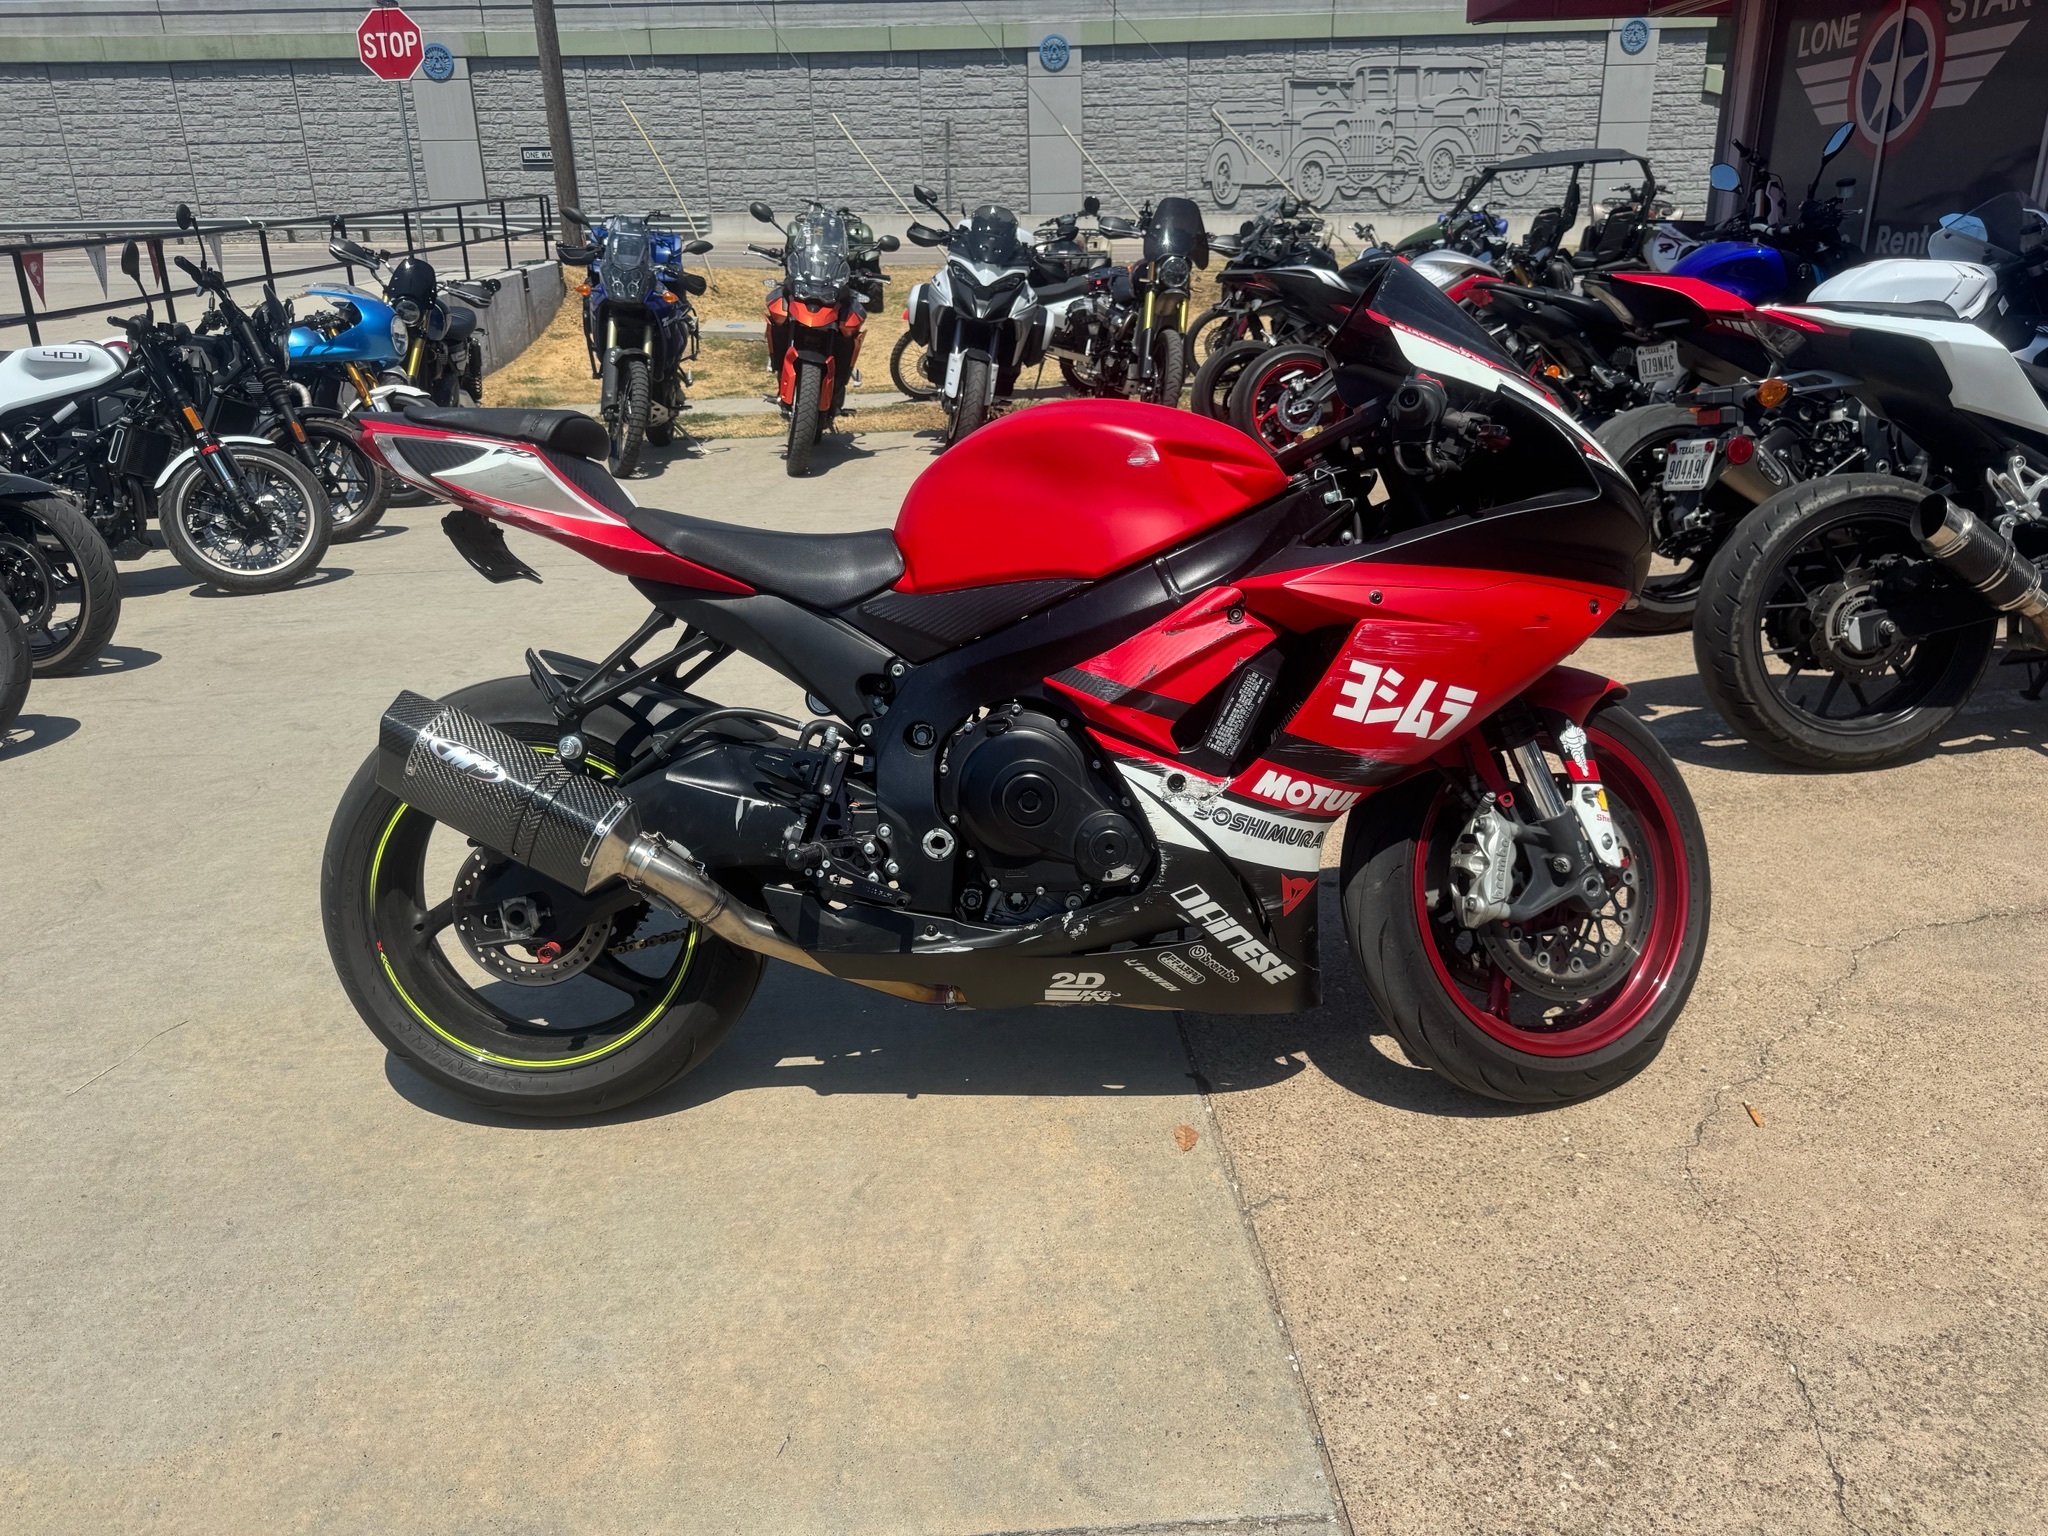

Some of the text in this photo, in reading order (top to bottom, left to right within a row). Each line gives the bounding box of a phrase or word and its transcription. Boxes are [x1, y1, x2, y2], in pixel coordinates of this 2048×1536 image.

[363, 31, 418, 58] STOP
[1797, 12, 1861, 58] LONE
[525, 151, 553, 159] ONE WA
[42, 351, 82, 360] 401
[1679, 446, 1695, 455] TEXAS
[1332, 659, 1478, 741] ヨシムラ
[1251, 769, 1362, 812] MOTUL
[1491, 837, 1510, 900] brembo
[1049, 972, 1106, 989] 2D
[1134, 966, 1182, 992] DRIVEN
